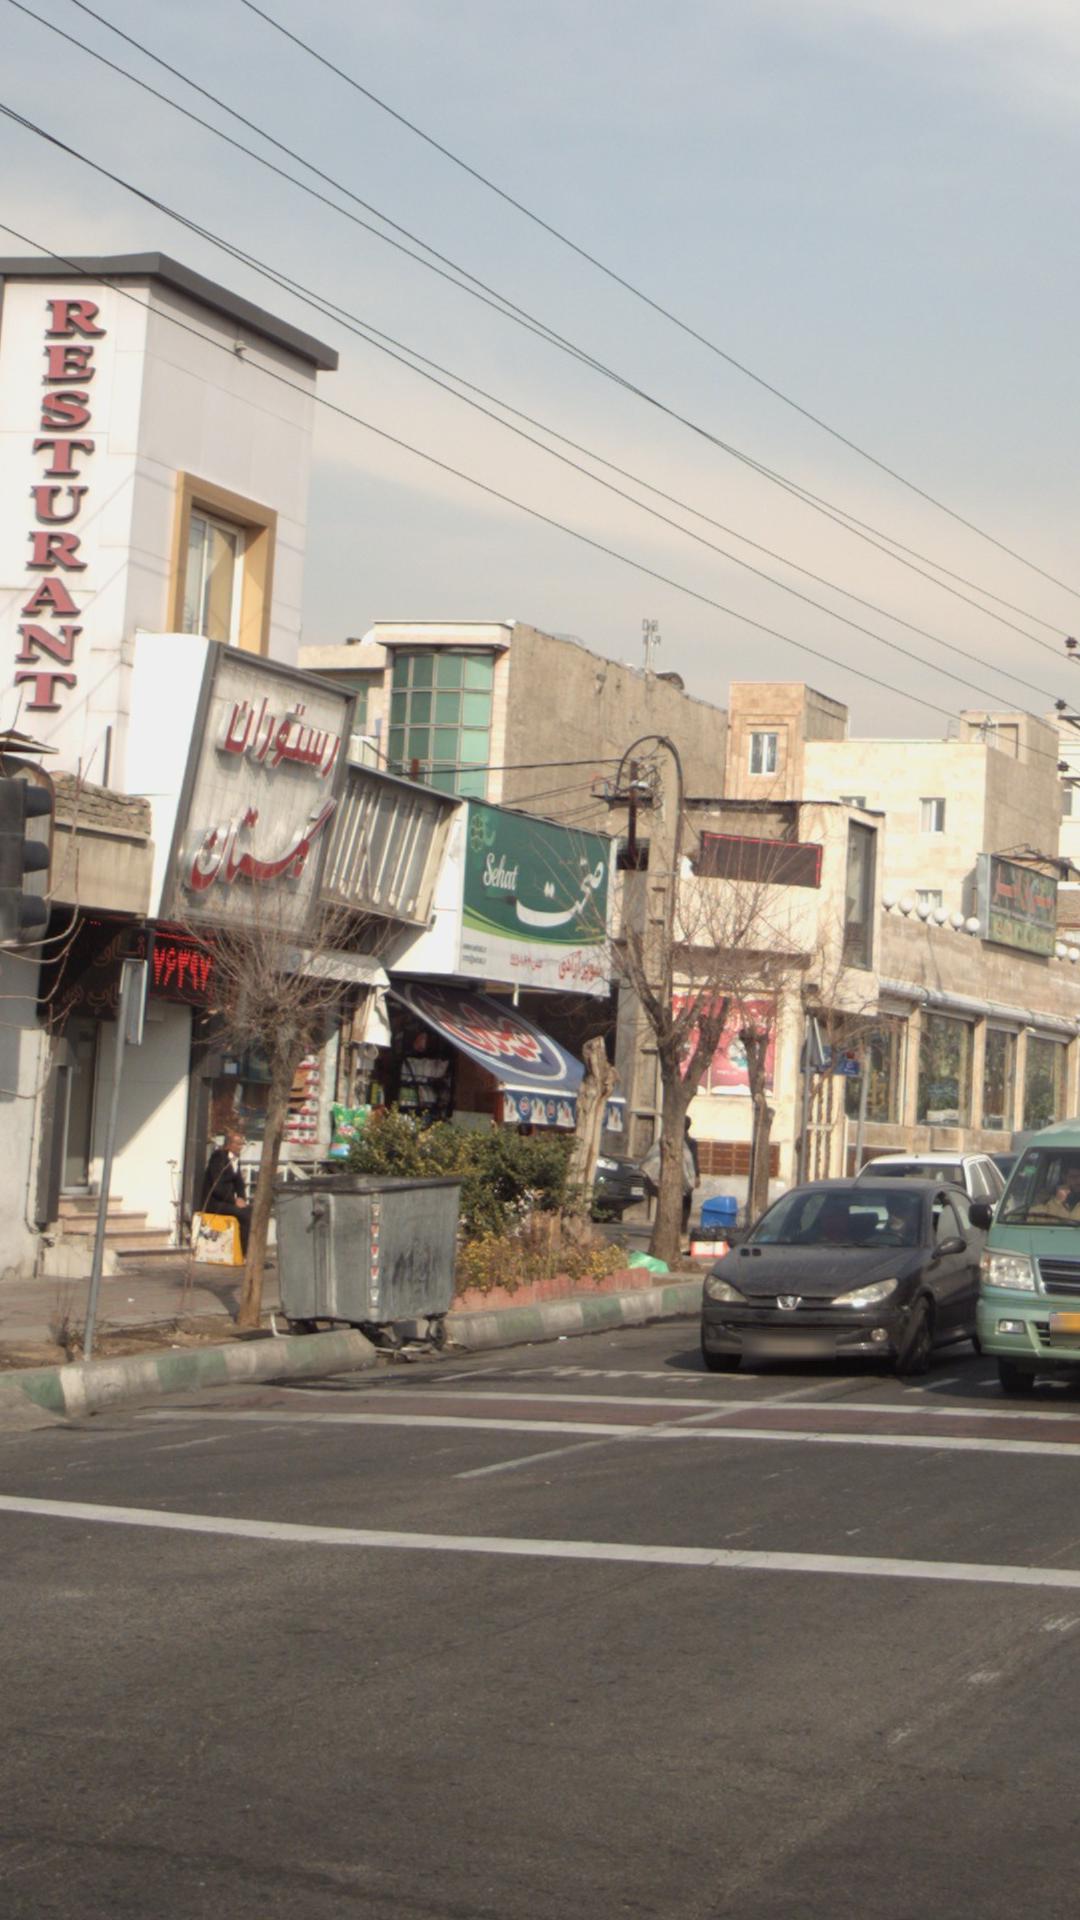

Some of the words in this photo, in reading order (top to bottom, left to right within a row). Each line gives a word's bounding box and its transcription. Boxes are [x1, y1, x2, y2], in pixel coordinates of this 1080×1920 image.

[15, 299, 106, 711] RESTURANT
[223, 697, 341, 779] رستوران
[483, 852, 519, 891] Sehat
